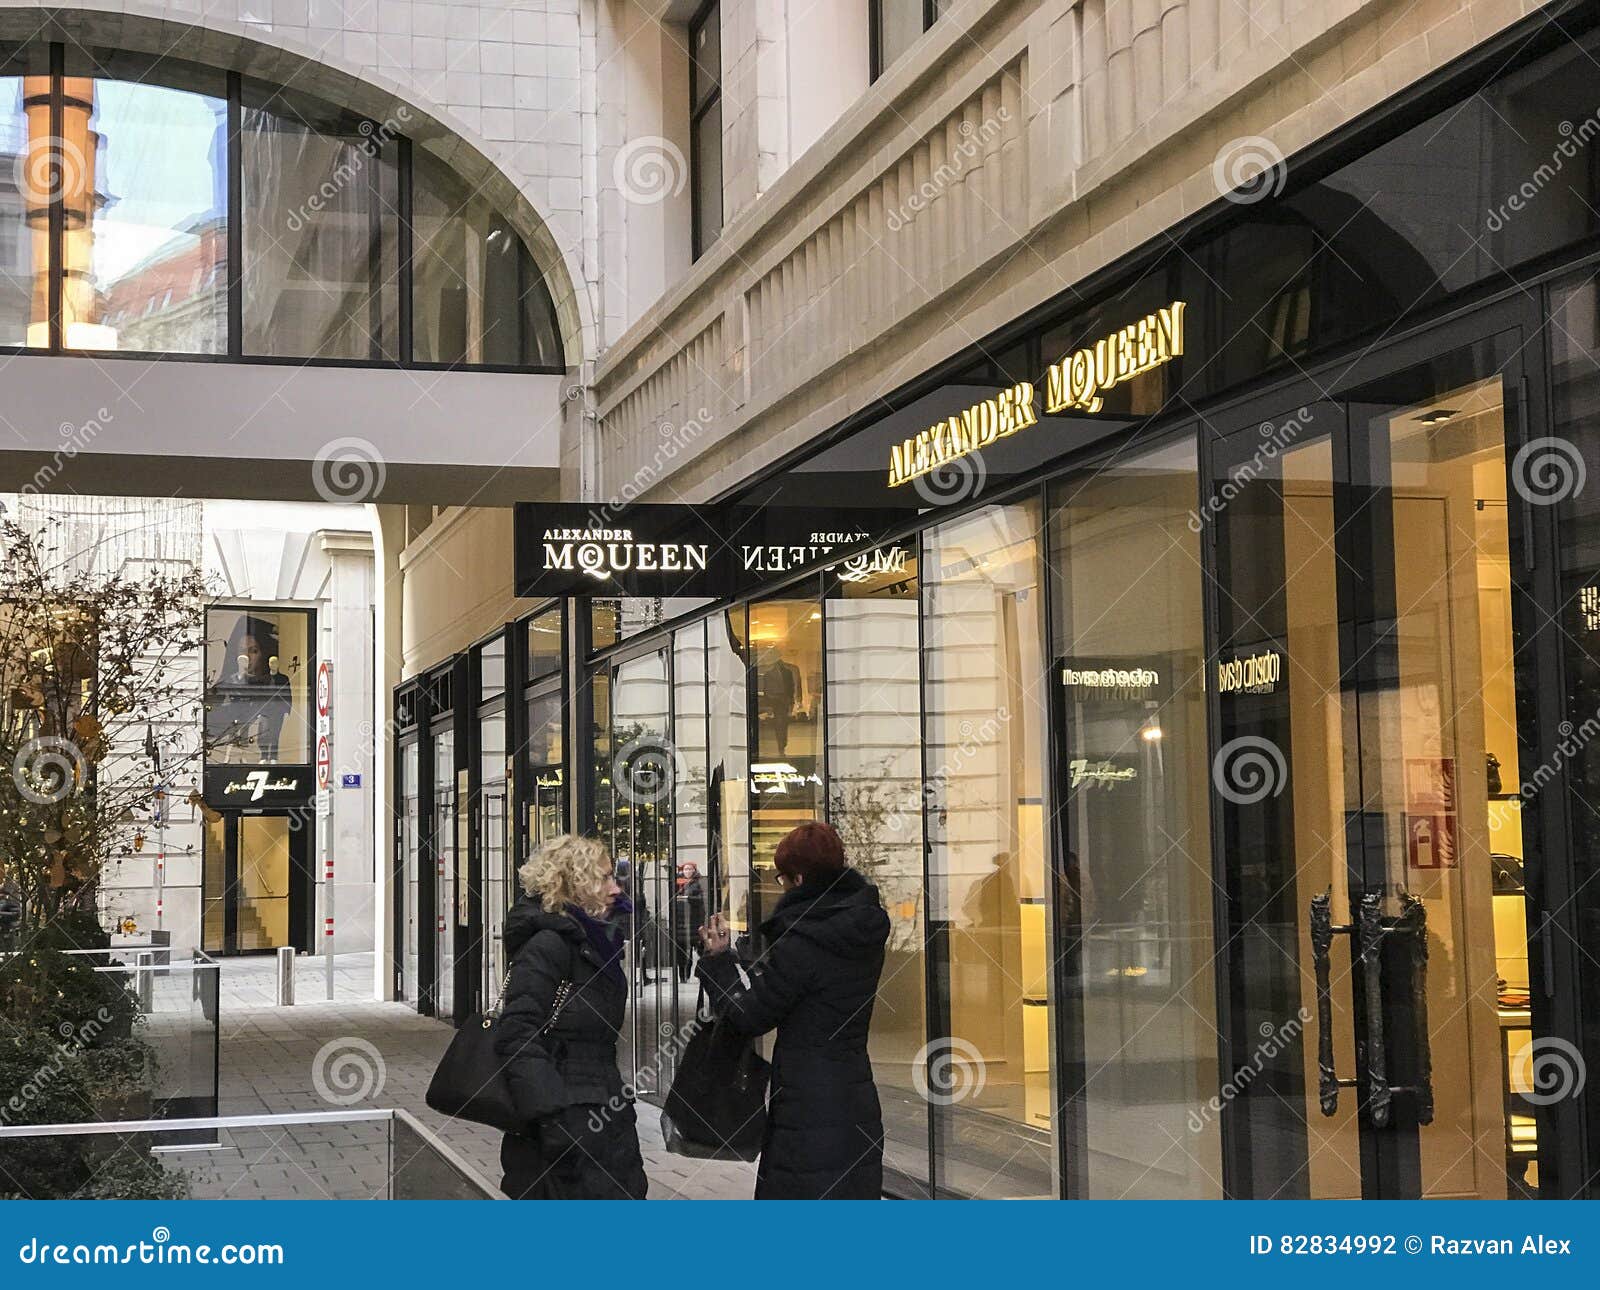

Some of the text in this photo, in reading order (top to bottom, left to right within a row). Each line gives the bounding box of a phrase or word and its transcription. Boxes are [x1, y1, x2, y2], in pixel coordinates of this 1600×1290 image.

[887, 381, 1038, 488] ALEXANDER
[543, 529, 633, 541] ALEXANDER
[348, 775, 355, 783] 3
